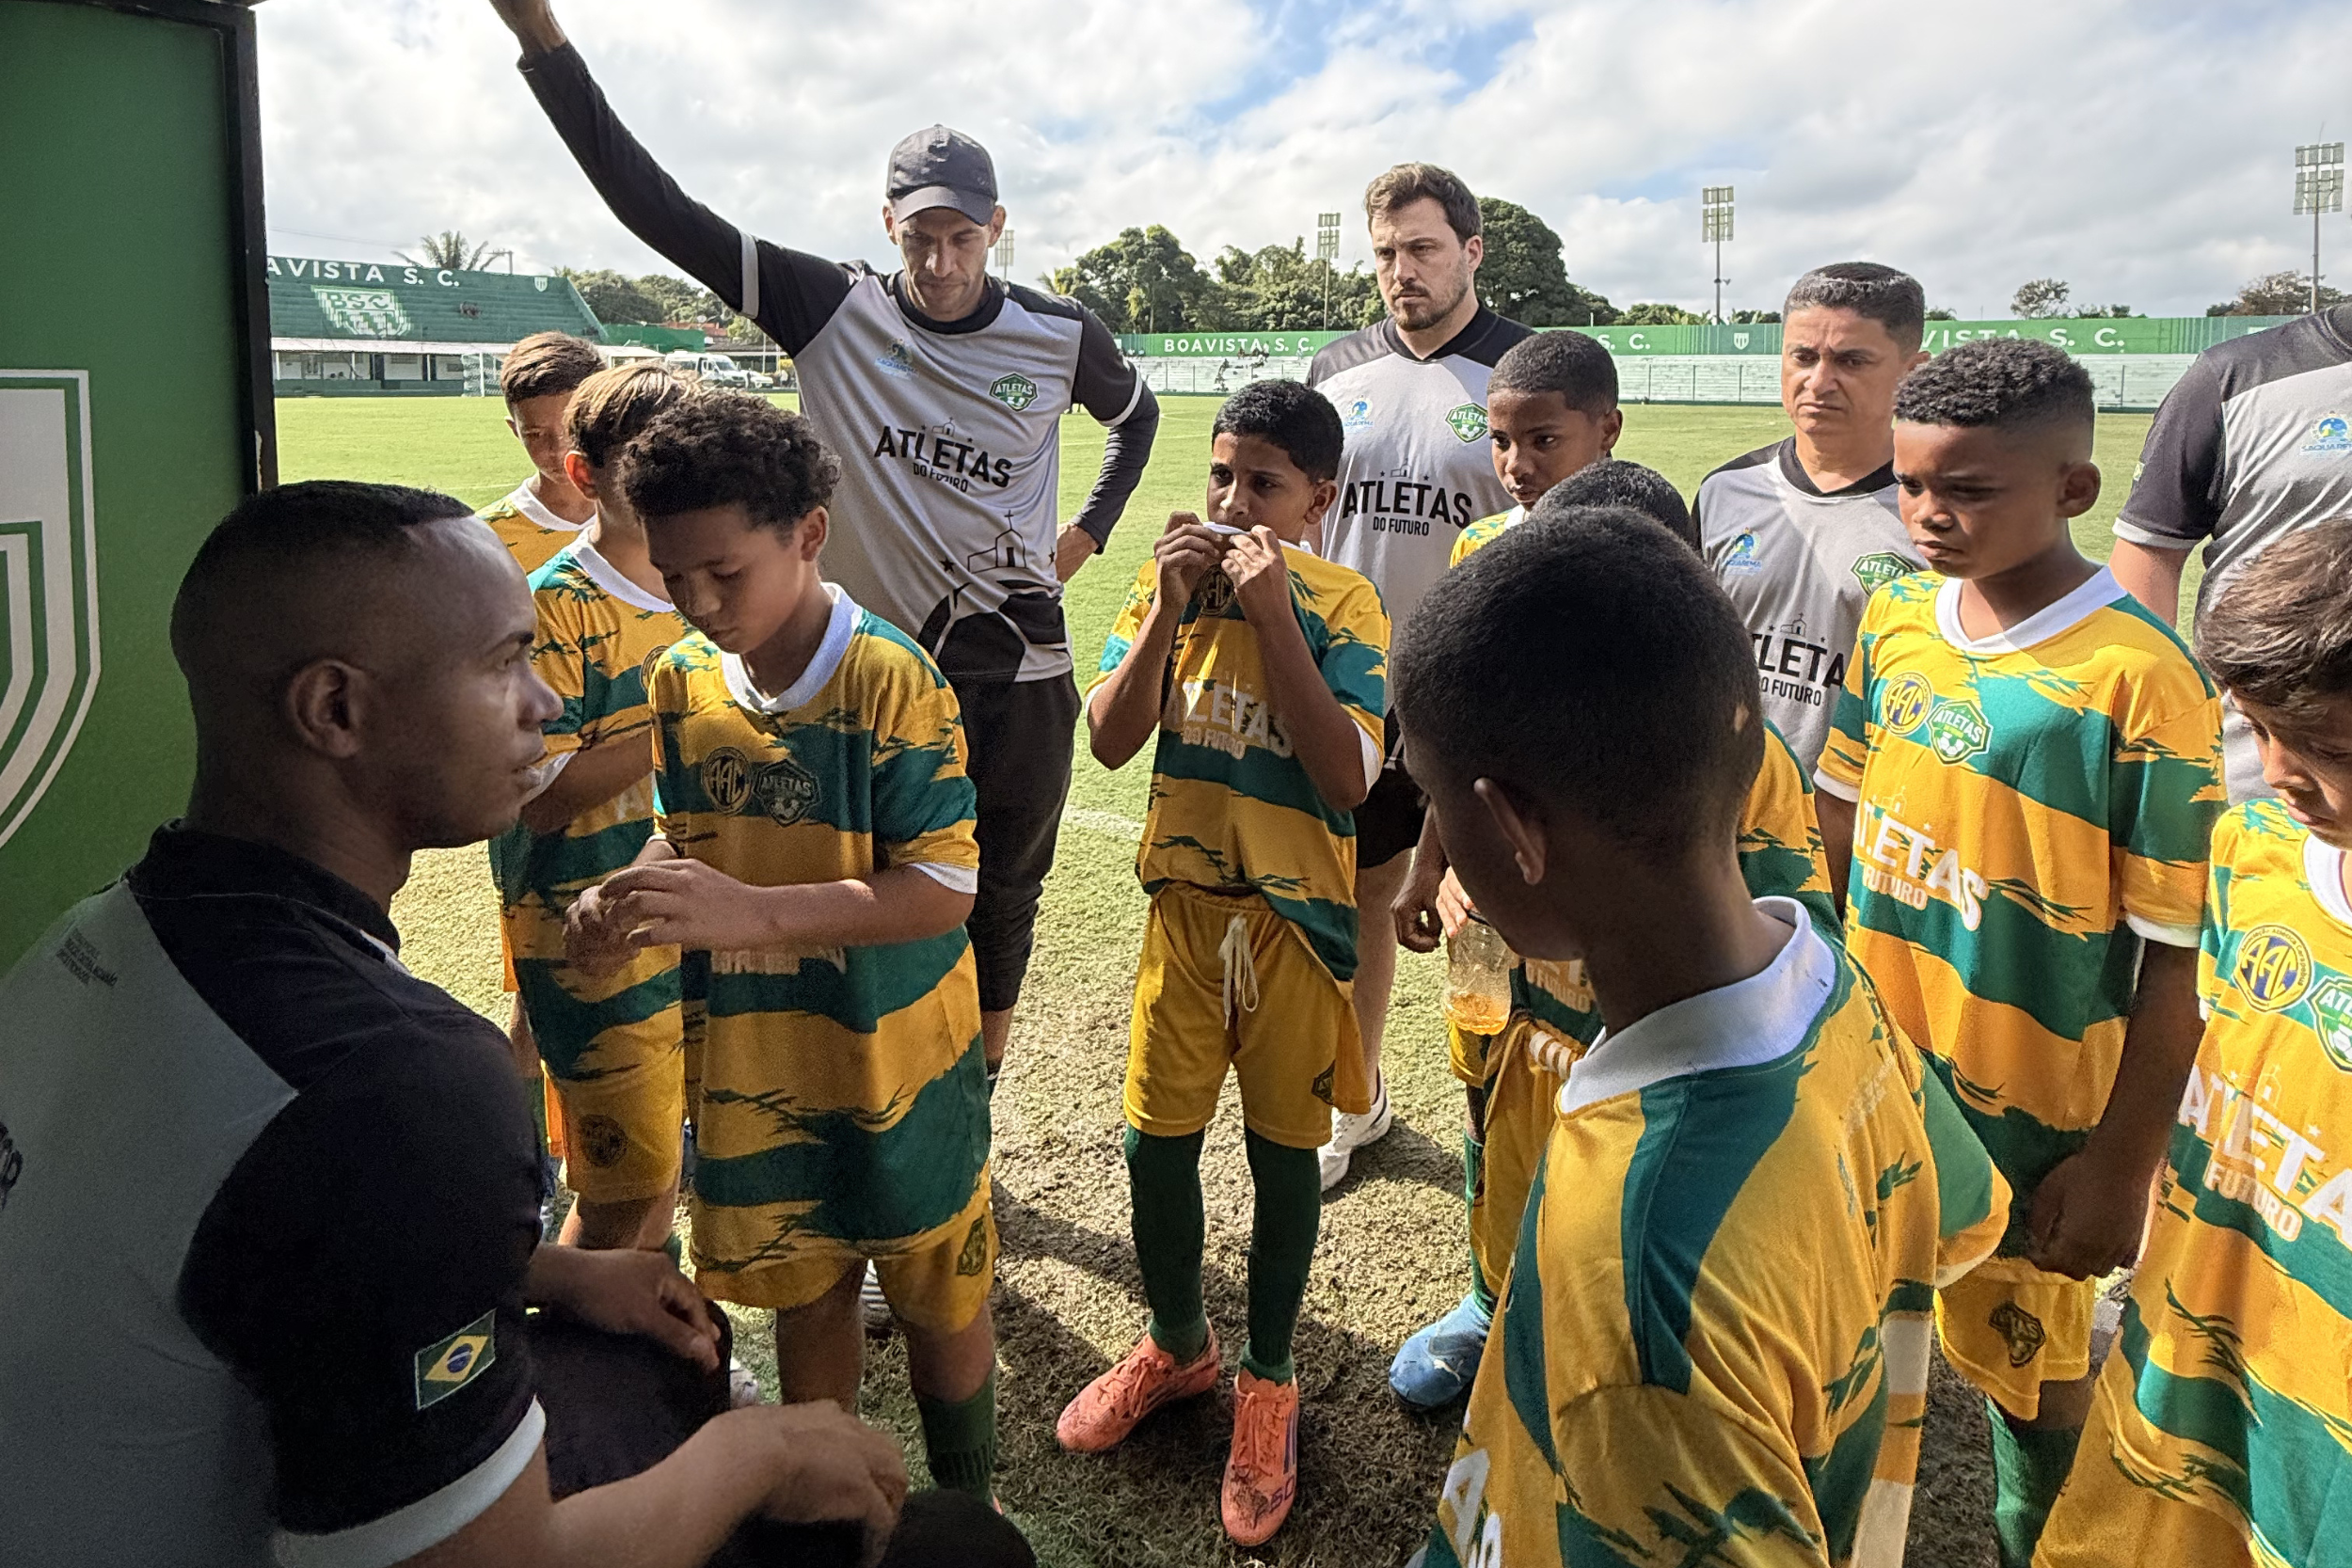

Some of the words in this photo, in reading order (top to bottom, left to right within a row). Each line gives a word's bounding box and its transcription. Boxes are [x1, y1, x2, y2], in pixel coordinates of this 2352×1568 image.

[404, 268, 424, 285] S.
[437, 270, 460, 287] C.
[330, 293, 389, 309] BSC
[1164, 338, 1263, 353] BOAVISTA
[1275, 337, 1289, 352] S.
[1297, 337, 1314, 352] C.
[1629, 333, 1651, 350] C.
[2049, 328, 2075, 347] S.
[2094, 327, 2125, 347] C.
[994, 382, 1033, 396] ATLETAS
[874, 425, 1013, 487] ATLETAS
[913, 462, 927, 477] DO
[1342, 480, 1472, 529] ATLETAS
[1373, 515, 1387, 531] DO
[1388, 518, 1430, 536] FUTURO
[1859, 560, 1910, 578] ATLETA
[1772, 678, 1821, 706] FUTURO
[1933, 708, 1983, 743] ATLETAS
[762, 775, 812, 797] ATLETAS
[1863, 863, 1929, 911] FUTURO
[2241, 937, 2297, 1001] AAC
[2203, 1160, 2303, 1243] FUTURO
